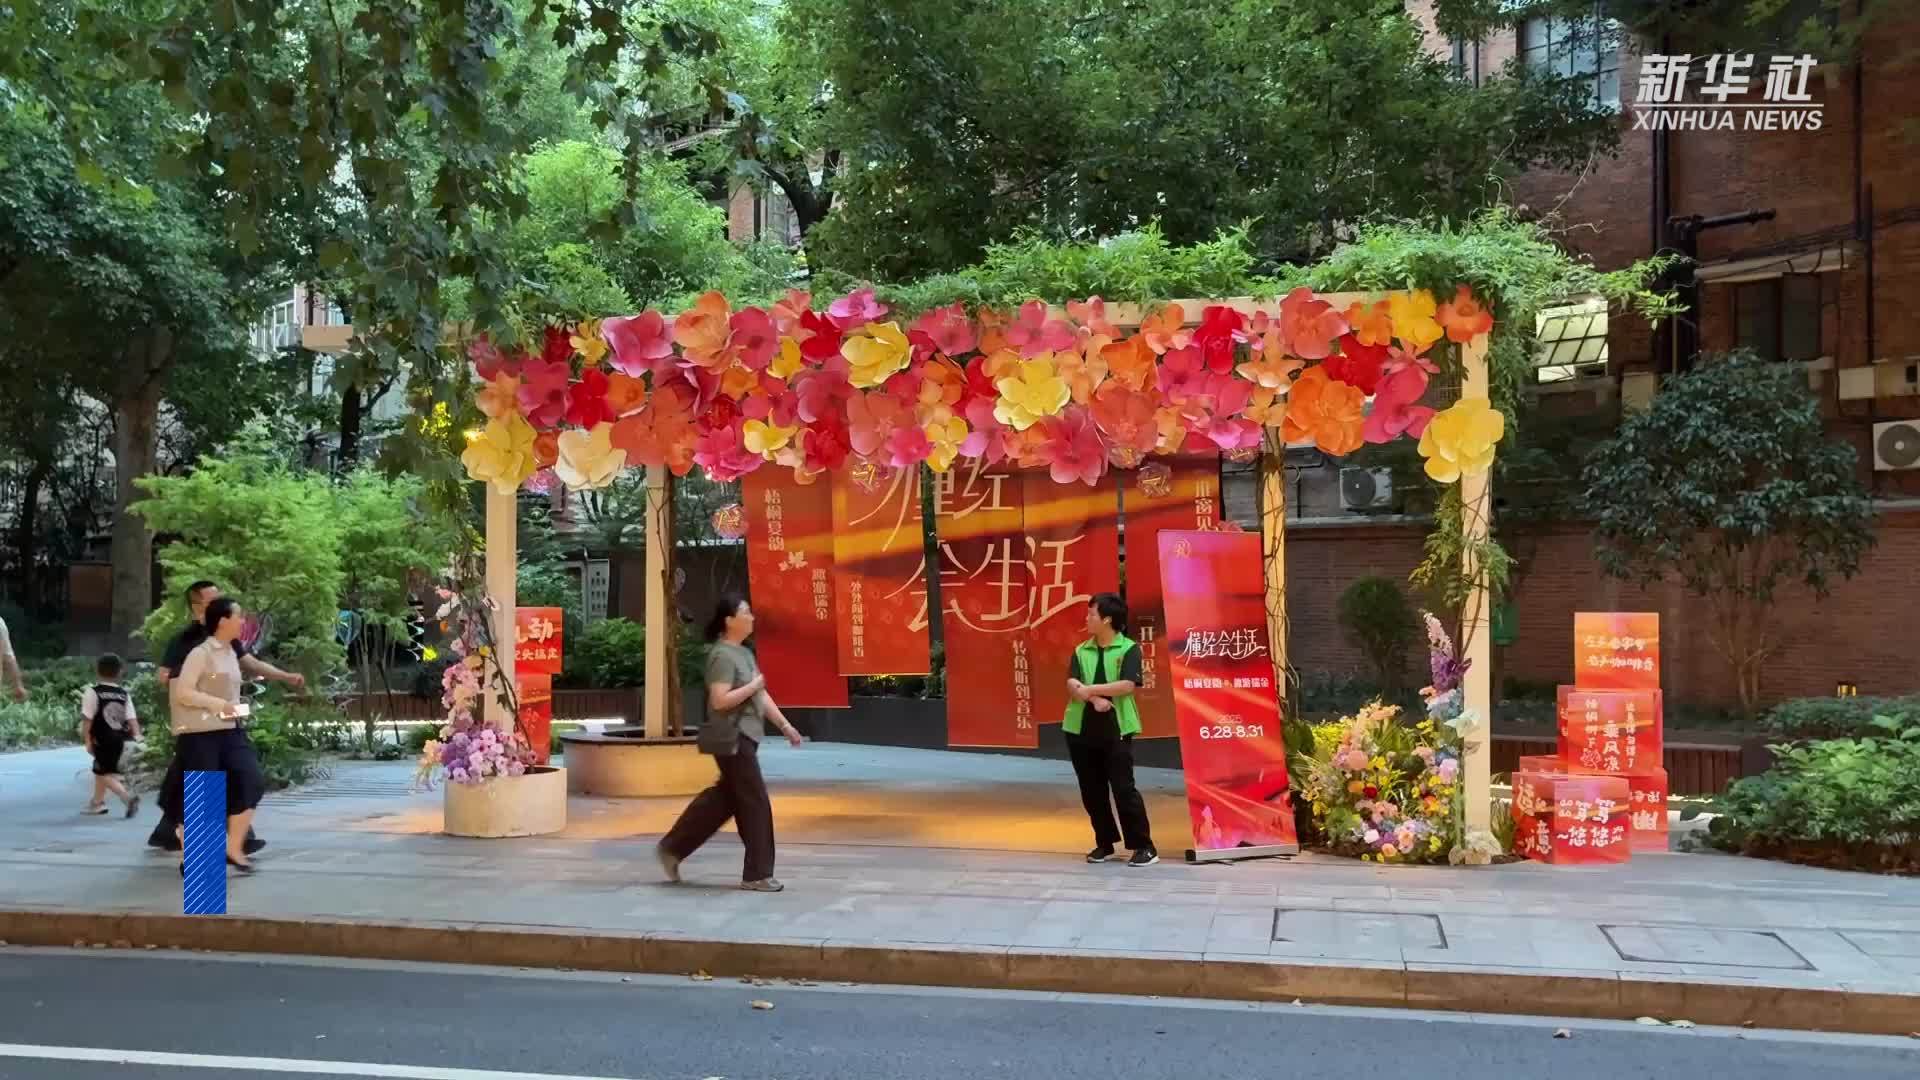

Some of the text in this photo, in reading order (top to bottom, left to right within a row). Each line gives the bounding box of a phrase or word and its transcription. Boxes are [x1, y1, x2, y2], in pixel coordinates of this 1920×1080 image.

[1176, 626, 1267, 667] 懂经会生活
[1200, 725, 1264, 740] 6.28-8.31
